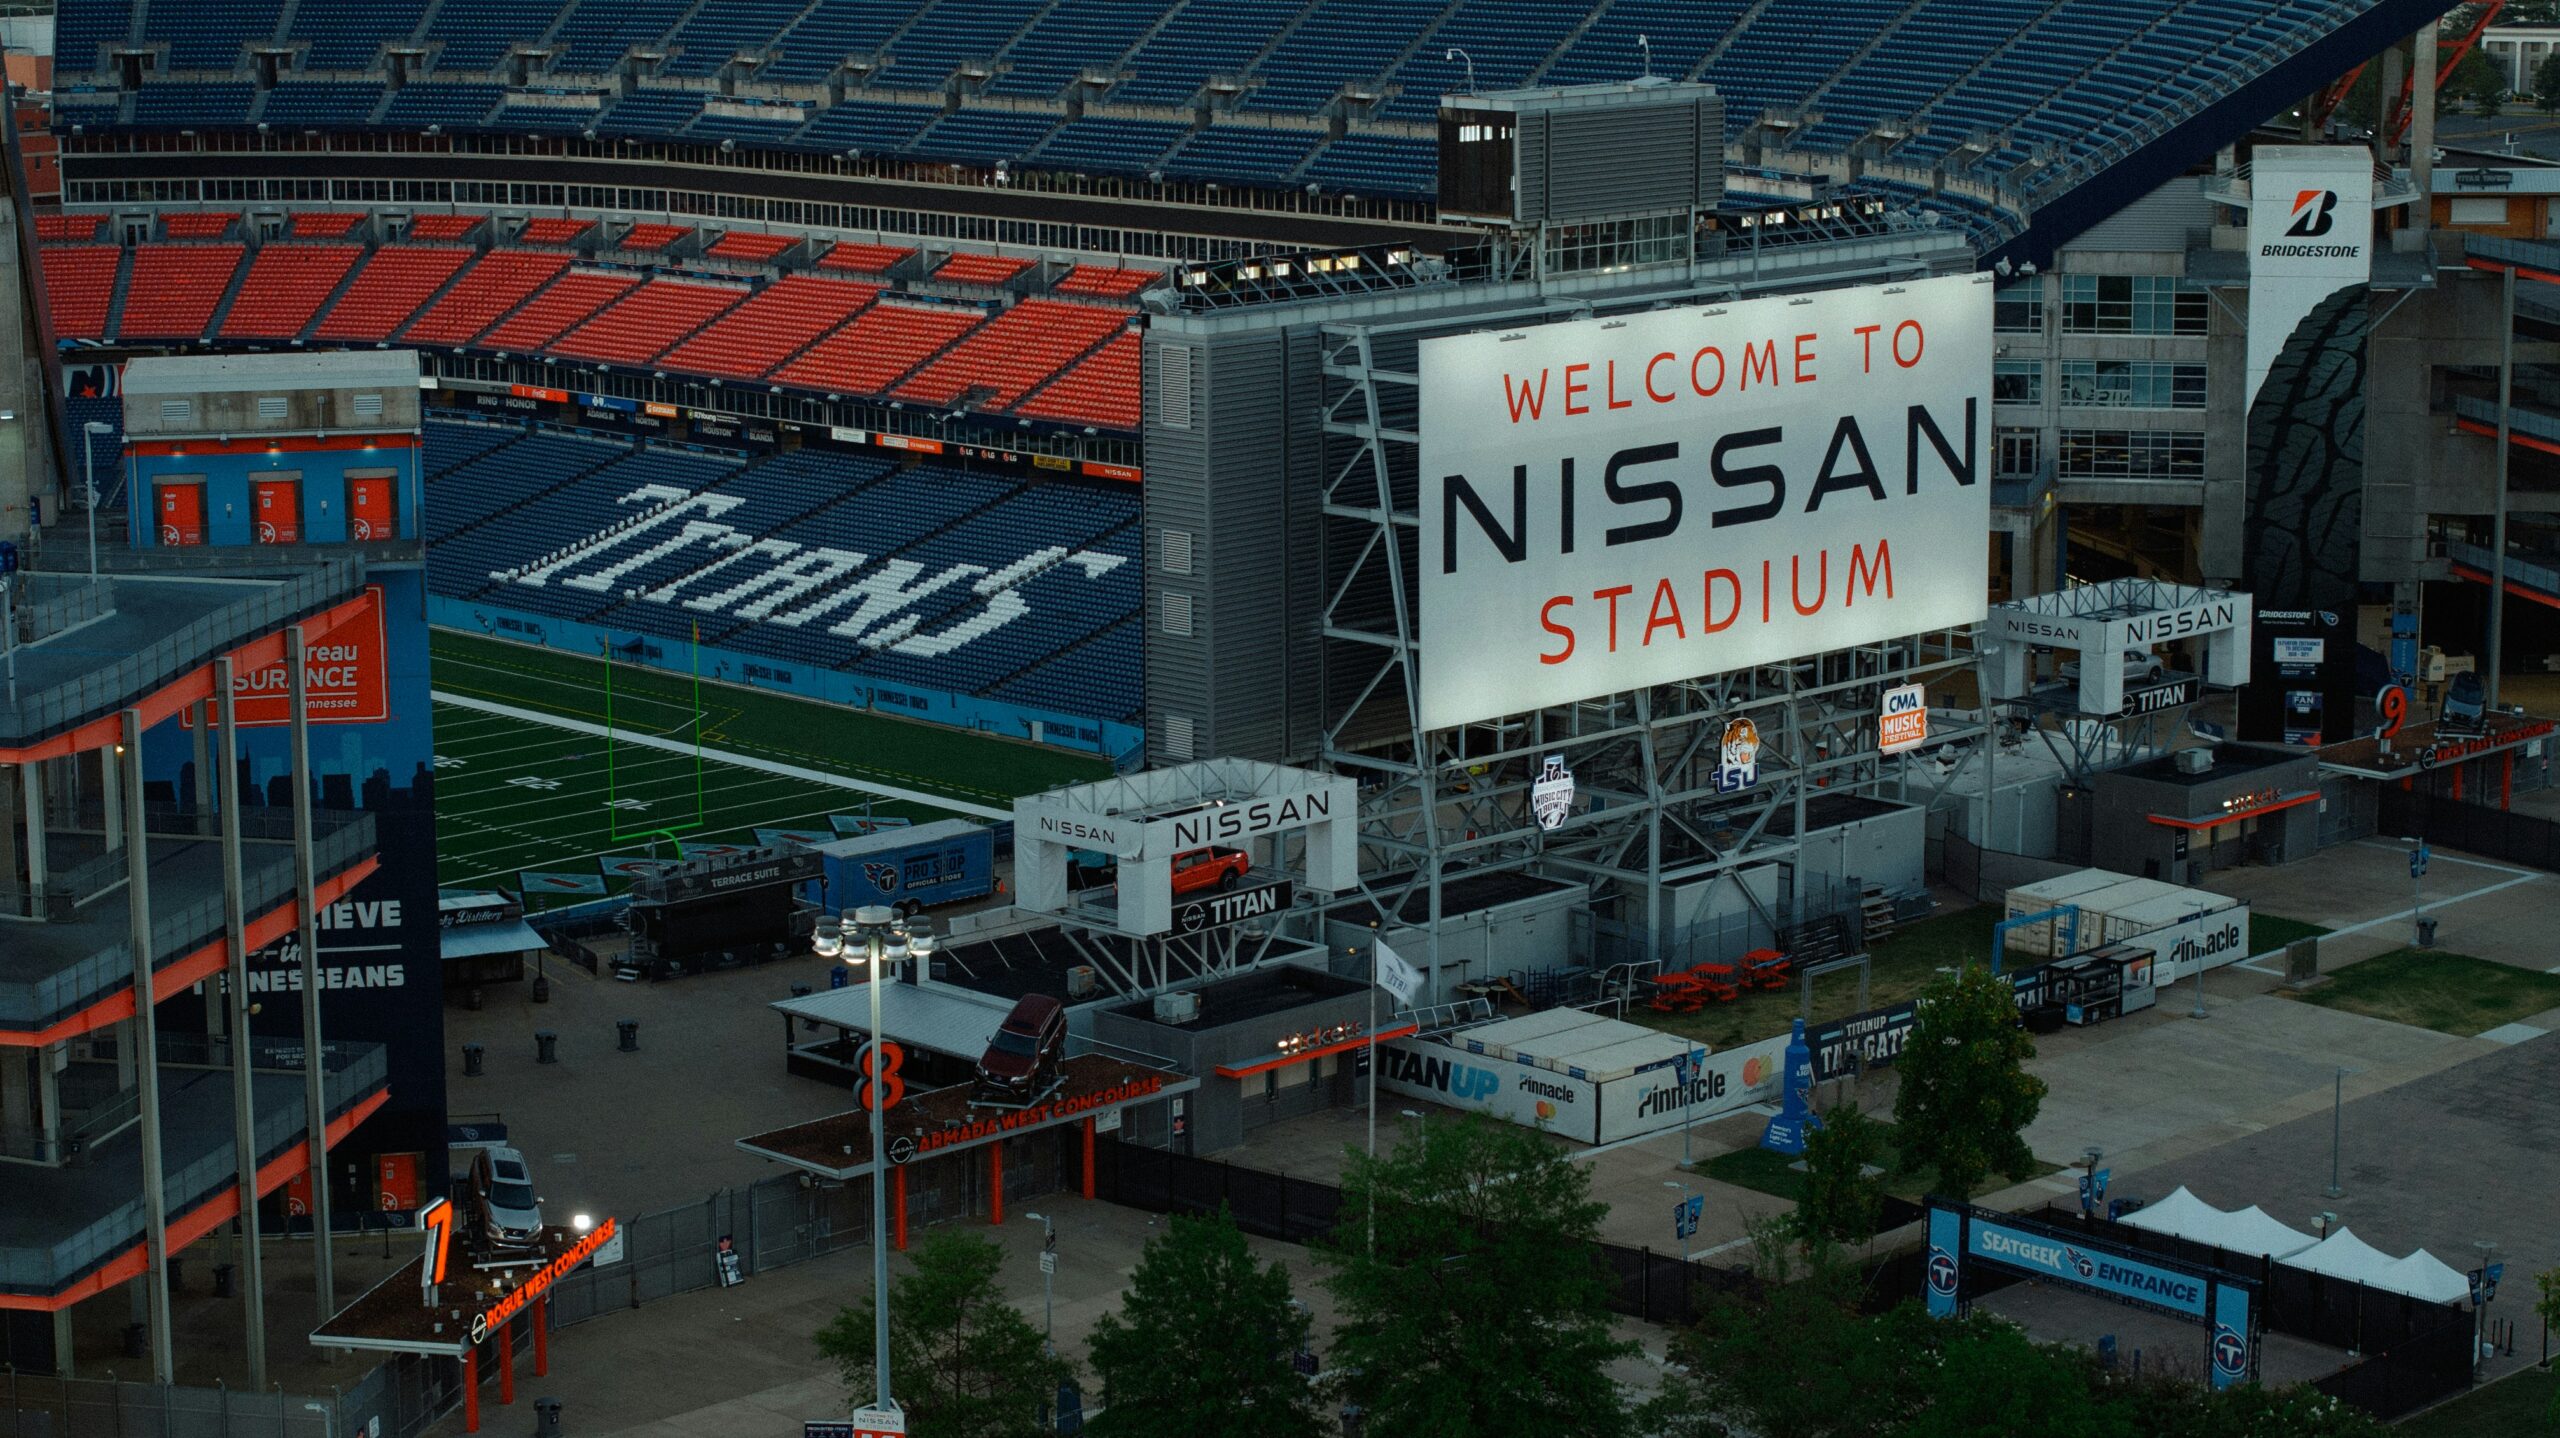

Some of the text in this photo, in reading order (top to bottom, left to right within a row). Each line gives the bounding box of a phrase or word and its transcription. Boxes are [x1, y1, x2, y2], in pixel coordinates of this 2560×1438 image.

[2261, 244, 2360, 258] BRIDGESTONE
[1503, 319, 1924, 424] WELCOME TO
[477, 394, 537, 410] RING HONOR
[1104, 468, 1132, 478] NISSAN
[1442, 396, 1977, 574] NISSAN
[1539, 538, 1894, 666] STADIUM
[2007, 619, 2079, 641] NISSAN
[2128, 602, 2234, 646] NISSAN
[1889, 691, 1918, 713] CMA
[2138, 681, 2186, 712] TITAN
[2293, 696, 2314, 705] FAN
[1884, 712, 1922, 735] MUSIC
[2380, 685, 2408, 740] 9
[1884, 727, 1922, 744] FESTIVAL
[1534, 787, 1574, 808] MUSIC CITY
[1543, 801, 1566, 814] BOWL
[1041, 816, 1114, 844] NISSAN
[1175, 790, 1328, 849] NISSAN
[711, 871, 753, 889] TERRACE
[754, 867, 781, 882] SUITE
[904, 860, 929, 880] PRO
[906, 878, 938, 889] OFFICIAL
[456, 909, 503, 925] Distillery
[1210, 886, 1276, 924] TITAN
[1846, 1015, 1887, 1038] TITANUP
[861, 1041, 906, 1113] 8
[1375, 1042, 1500, 1102] ITANUP
[1519, 1073, 1575, 1104] Pinnacle
[1638, 1070, 1726, 1119] Pinnacle
[915, 1075, 1163, 1154] ARMADA WEST CONCOURSE
[1981, 1229, 2063, 1272] SEATGEEK
[486, 1286, 525, 1329] ROGUE
[523, 1262, 553, 1304] WEST
[551, 1216, 616, 1279] CONCOURSE
[2098, 1261, 2198, 1305] ENTRANCE
[858, 1417, 899, 1427] NISSAN
